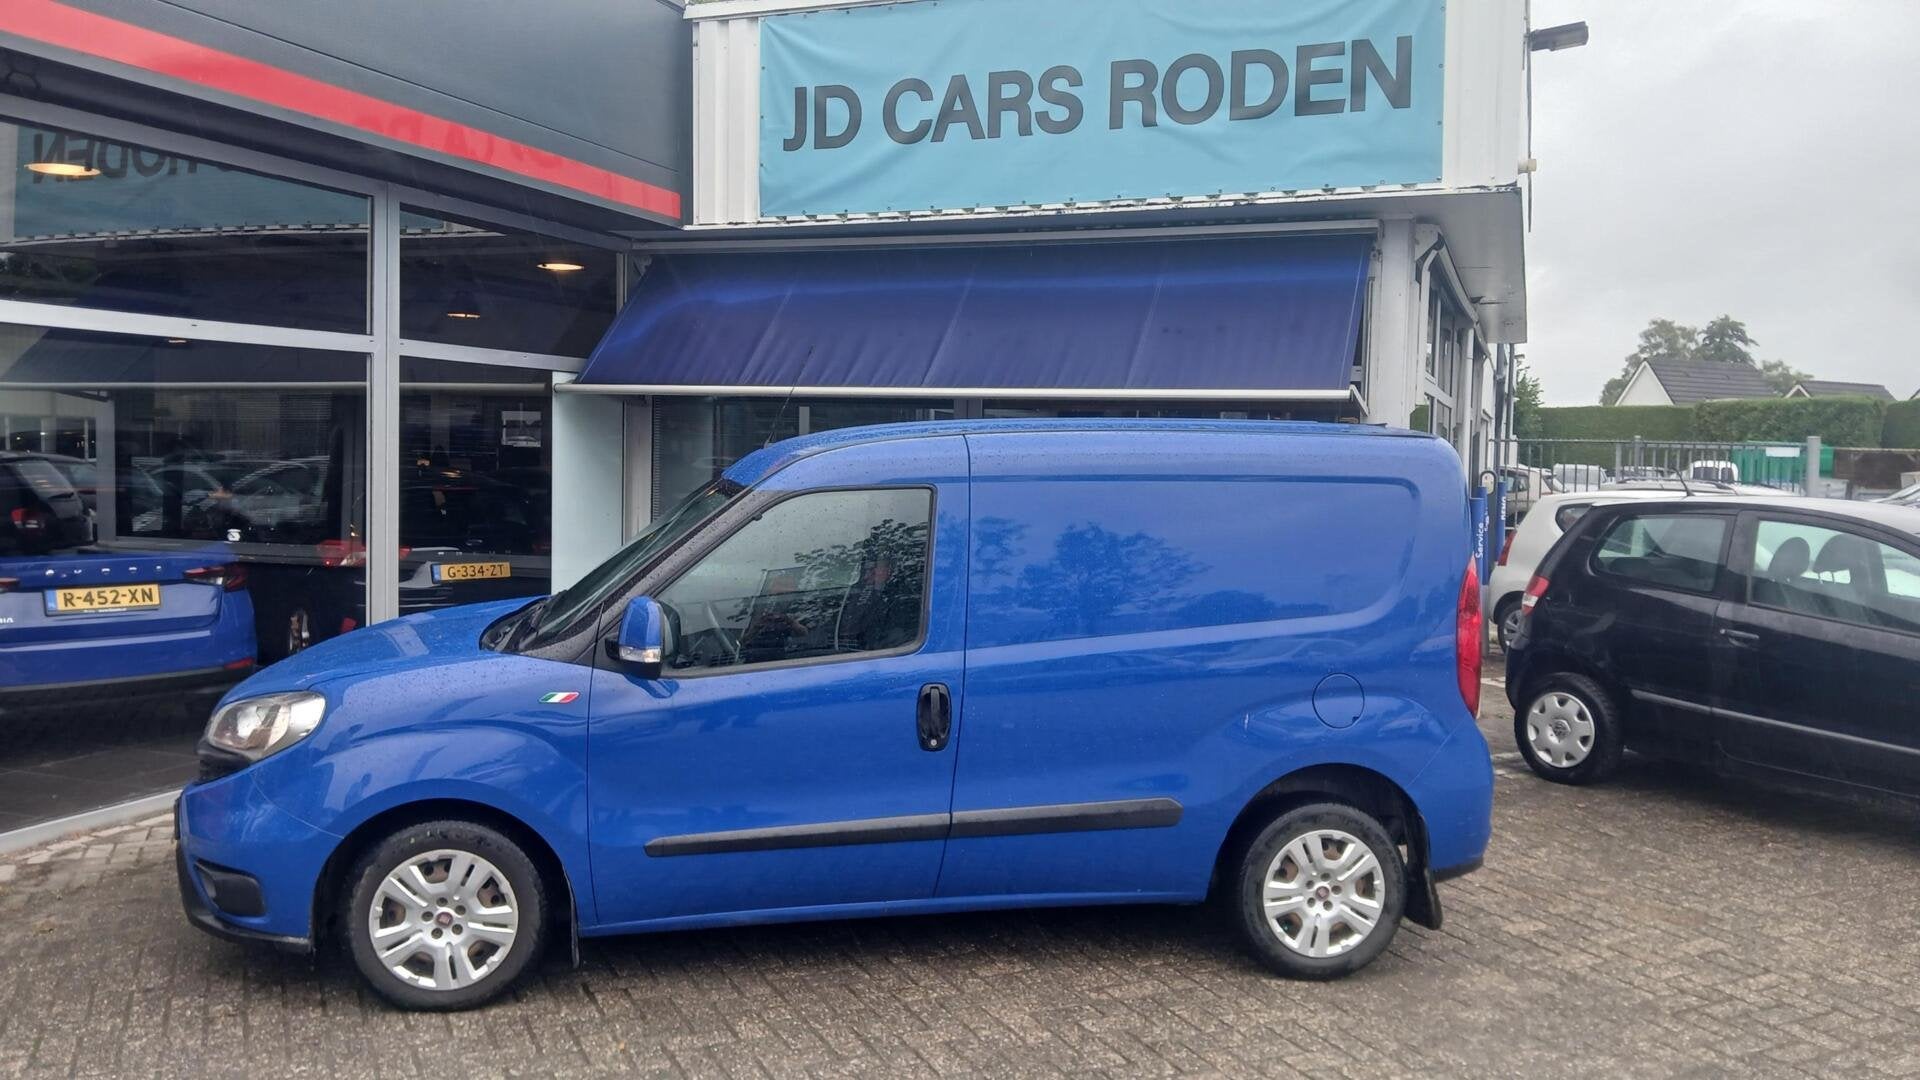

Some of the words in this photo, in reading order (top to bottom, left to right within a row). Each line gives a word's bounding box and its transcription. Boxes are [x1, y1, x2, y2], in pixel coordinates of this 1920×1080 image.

[783, 85, 862, 152] JD
[882, 65, 1084, 145] CARS
[1108, 35, 1413, 130] RODEN
[1475, 522, 1484, 559] Service
[447, 564, 504, 579] G-334-ZT
[63, 587, 154, 608] R-452-XN
